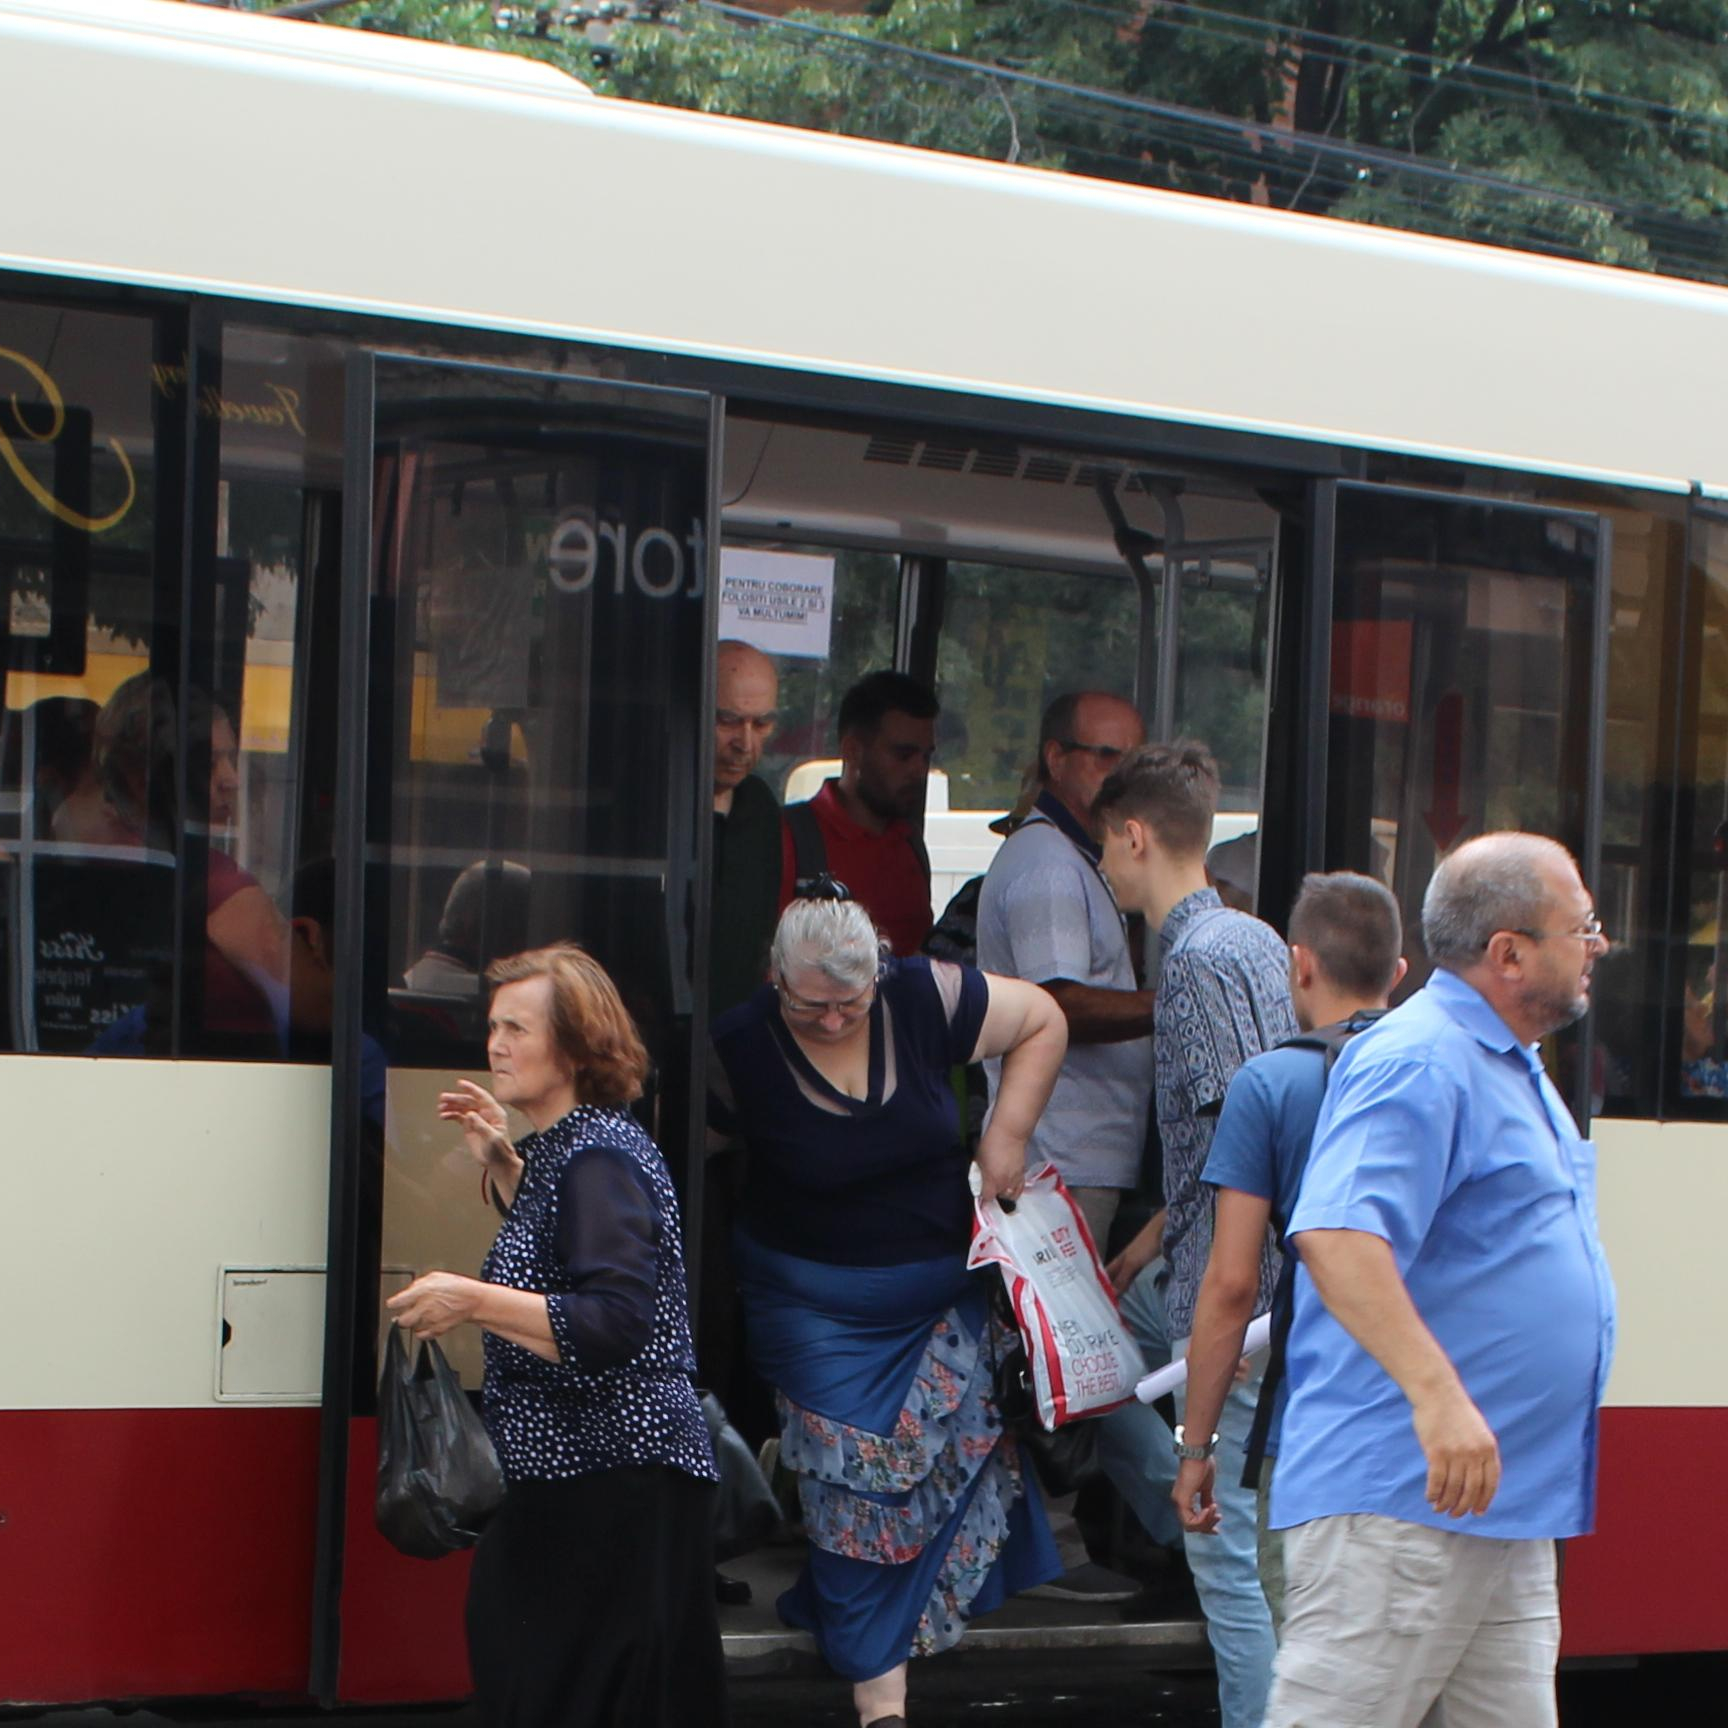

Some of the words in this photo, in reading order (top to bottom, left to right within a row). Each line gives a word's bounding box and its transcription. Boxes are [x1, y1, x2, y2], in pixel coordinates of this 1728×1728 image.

[725, 577, 766, 590] PENTRU
[768, 581, 823, 595] COBORARE
[721, 590, 767, 604] FOLOSITI
[738, 607, 751, 616] VA
